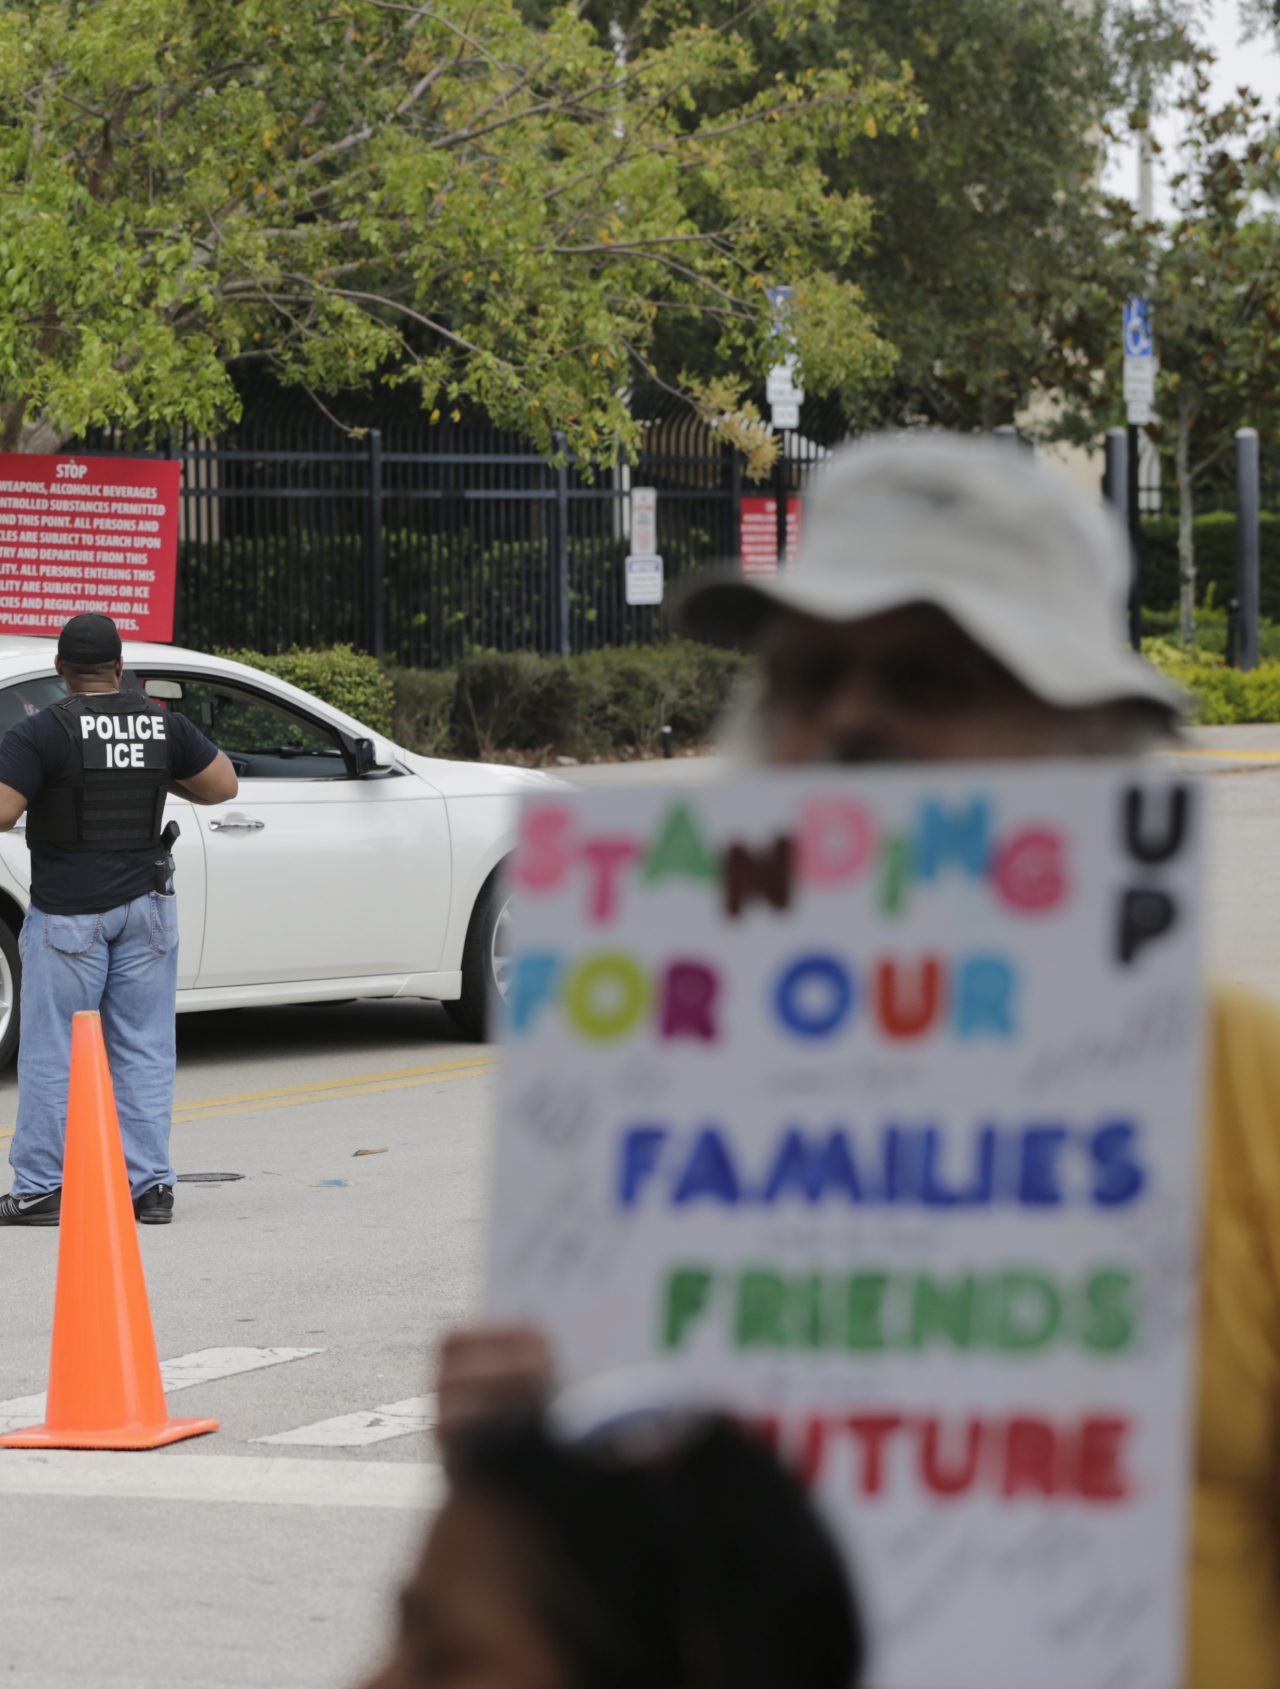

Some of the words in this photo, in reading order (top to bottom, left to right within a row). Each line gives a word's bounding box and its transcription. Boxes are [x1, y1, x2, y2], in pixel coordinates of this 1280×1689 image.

[56, 464, 88, 478] STOP
[50, 483, 102, 496] ALCOHOLIC
[102, 485, 158, 499] BEVERAGES
[50, 500, 110, 514] SUBSTANCES
[111, 502, 166, 516] PERMITTED
[18, 514, 40, 526] THIS
[41, 516, 73, 528] POINT.
[74, 517, 92, 529] ALL
[93, 518, 136, 532] PERSONS
[138, 520, 160, 533] AND
[20, 531, 38, 543] ARE
[40, 532, 80, 545] SUBJECT
[82, 534, 94, 546] TO
[95, 535, 132, 548] SEARCH
[133, 537, 162, 549] UPON
[17, 548, 38, 559] AND
[40, 548, 95, 562] DEPARTURE
[96, 551, 124, 564] FROM
[126, 553, 148, 565] THIS
[20, 564, 38, 576] ALL
[40, 565, 82, 578] PERSONS
[84, 567, 132, 580] ENTERING
[133, 570, 156, 582] THIS
[22, 581, 40, 593] ARE
[42, 582, 82, 595] SUBJECT
[84, 584, 97, 596] TO
[98, 584, 118, 597] DHS
[120, 586, 134, 598] OR
[134, 586, 150, 598] ICE
[22, 597, 42, 610] AND
[44, 598, 108, 612] REGULATIONS
[110, 601, 131, 614] AND
[132, 603, 150, 615] ALL
[80, 715, 166, 740] POLICE
[106, 744, 145, 768] ICE
[512, 798, 1074, 922] STANDING
[1116, 784, 1192, 966] UP
[506, 952, 722, 1043] FOR
[773, 953, 1018, 1041] OUR
[617, 1119, 1147, 1214] FAMILIES
[660, 1266, 1136, 1354] FRIENDS
[765, 1412, 1130, 1505] UTURE
